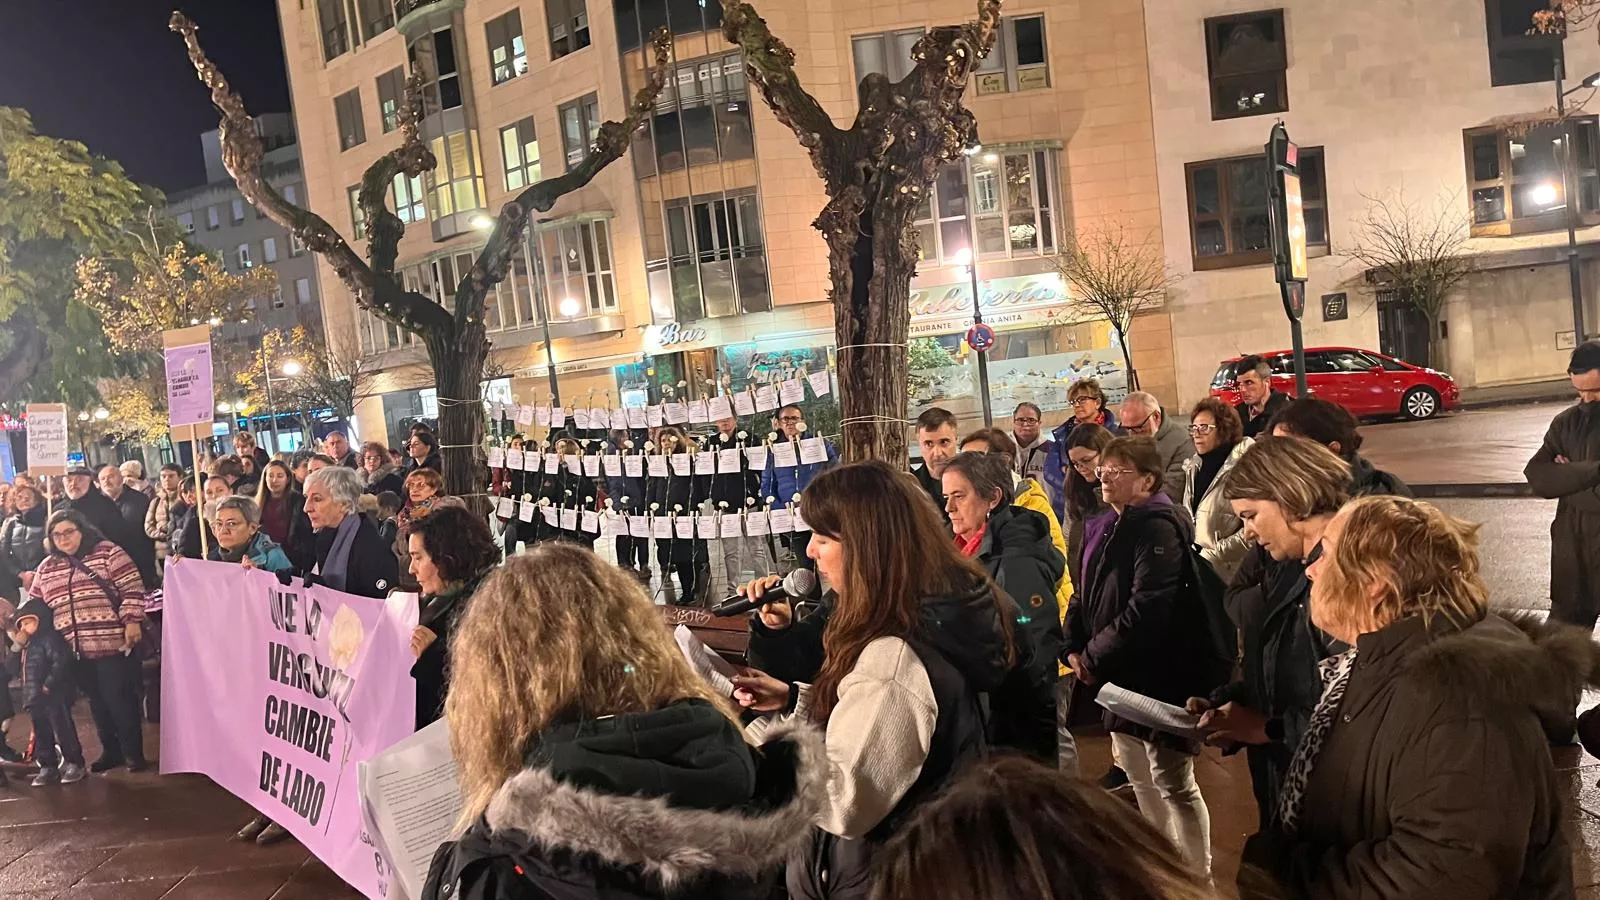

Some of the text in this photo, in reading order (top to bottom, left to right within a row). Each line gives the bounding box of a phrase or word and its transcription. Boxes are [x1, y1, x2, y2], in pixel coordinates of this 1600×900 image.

[658, 321, 707, 347] Bar
[909, 322, 952, 334] TAURANTE
[997, 314, 1023, 323] ANITA
[264, 695, 337, 763] CAMBIE
[259, 751, 282, 799] DE
[281, 763, 326, 827] LADO
